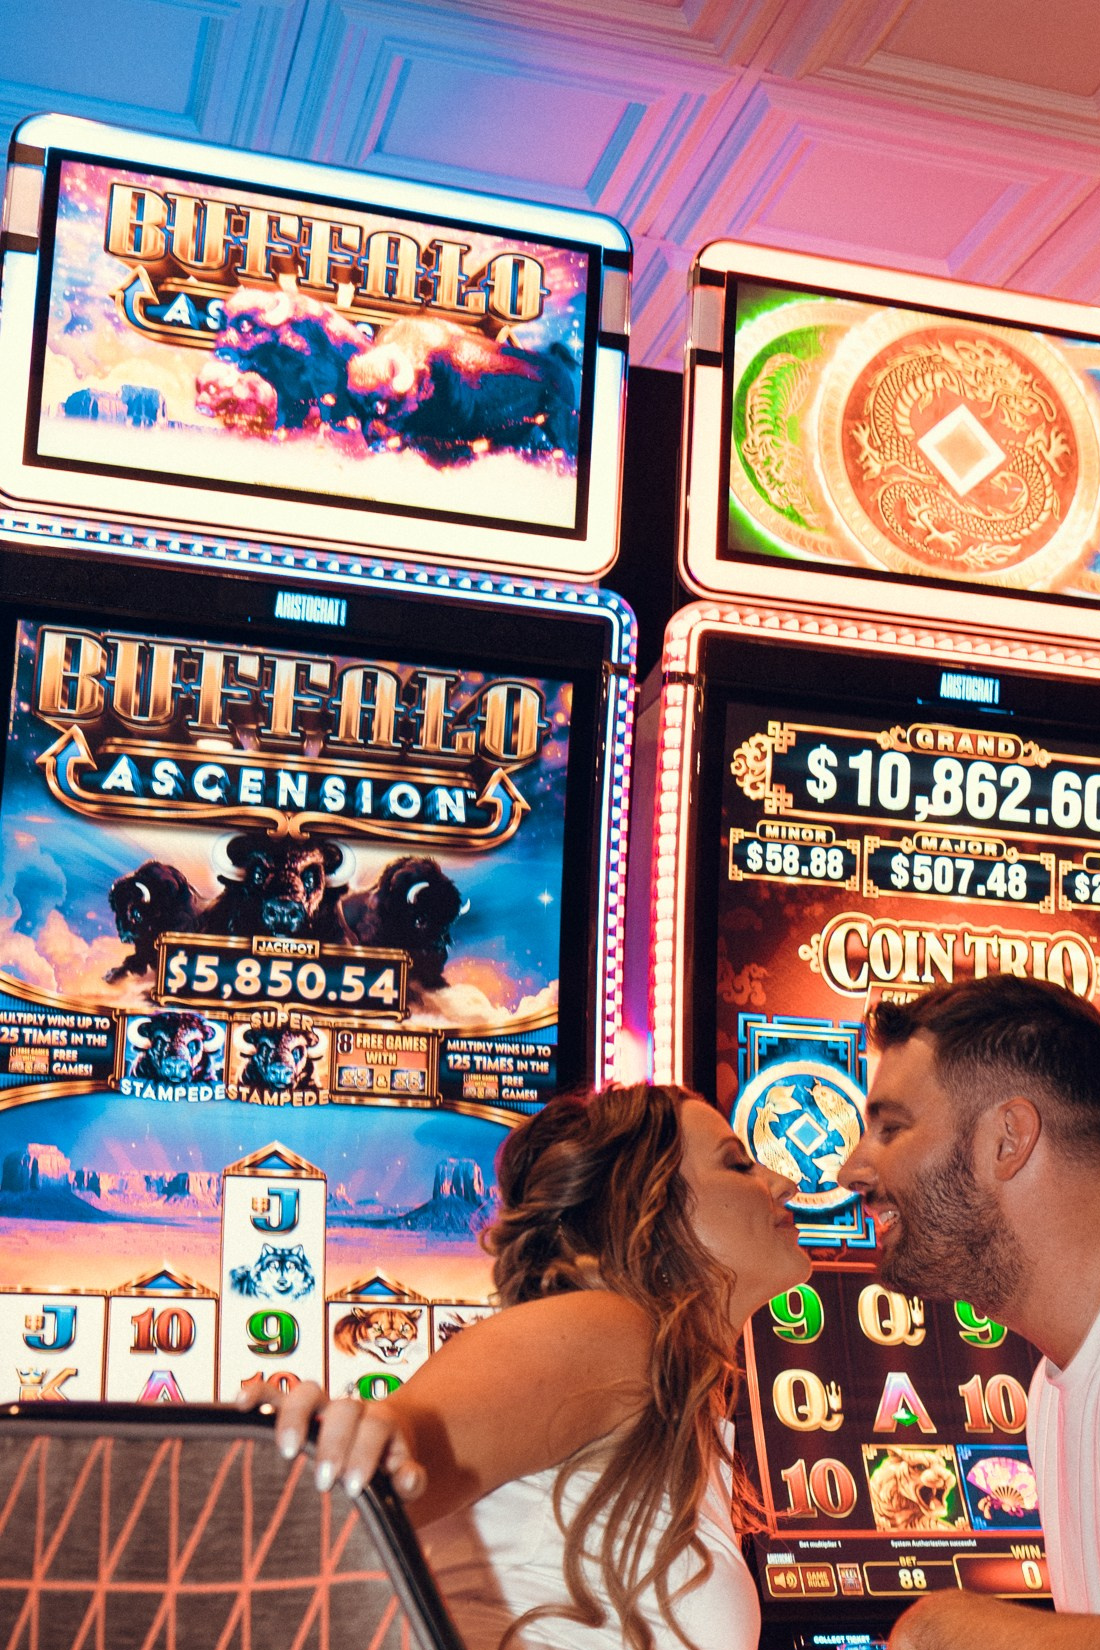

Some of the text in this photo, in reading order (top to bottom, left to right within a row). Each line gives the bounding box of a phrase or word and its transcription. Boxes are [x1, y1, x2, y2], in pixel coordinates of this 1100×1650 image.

[104, 182, 551, 323] BUFFALO
[274, 591, 340, 626] ARISTOCRAT
[35, 624, 553, 762] BUFFALO
[916, 729, 1016, 759] GRAND
[101, 754, 468, 824] ASCENSION
[766, 825, 827, 844] MINOR
[921, 836, 998, 857] MAJOR
[746, 840, 844, 880] $58.88
[890, 852, 1027, 900] $507.48
[258, 941, 314, 955] JACKPOT
[828, 920, 957, 989] COIN
[167, 951, 398, 1004] $5,850.54
[0, 1010, 110, 1030] ULTIPLY WINS UP TO
[250, 1012, 314, 1032] SUPER
[22, 1028, 68, 1047] TIMES
[71, 1033, 84, 1046] IN
[86, 1034, 107, 1048] THE
[337, 1030, 427, 1054] 8 FREE GAMES
[447, 1040, 551, 1058] MULTIPLY WINS UP TO
[53, 1048, 78, 1062] FREE
[365, 1051, 397, 1065] WITH
[447, 1054, 549, 1073] 125 TIMES IN THE
[53, 1062, 93, 1076] GAMES!
[502, 1075, 524, 1087] FREE
[120, 1078, 225, 1102] STAMPEDE
[228, 1085, 329, 1106] STAMPEDE
[502, 1088, 538, 1101] GAMES!
[130, 1307, 196, 1355] 10
[245, 1309, 300, 1358] 9
[772, 1369, 844, 1432] Q
[873, 1371, 937, 1434] A
[958, 1374, 1029, 1435] 10
[781, 1457, 857, 1519] 10
[899, 1556, 916, 1567] BET
[1011, 1545, 1041, 1560] WIN
[898, 1568, 927, 1590] 88
[1021, 1560, 1043, 1590] 0
